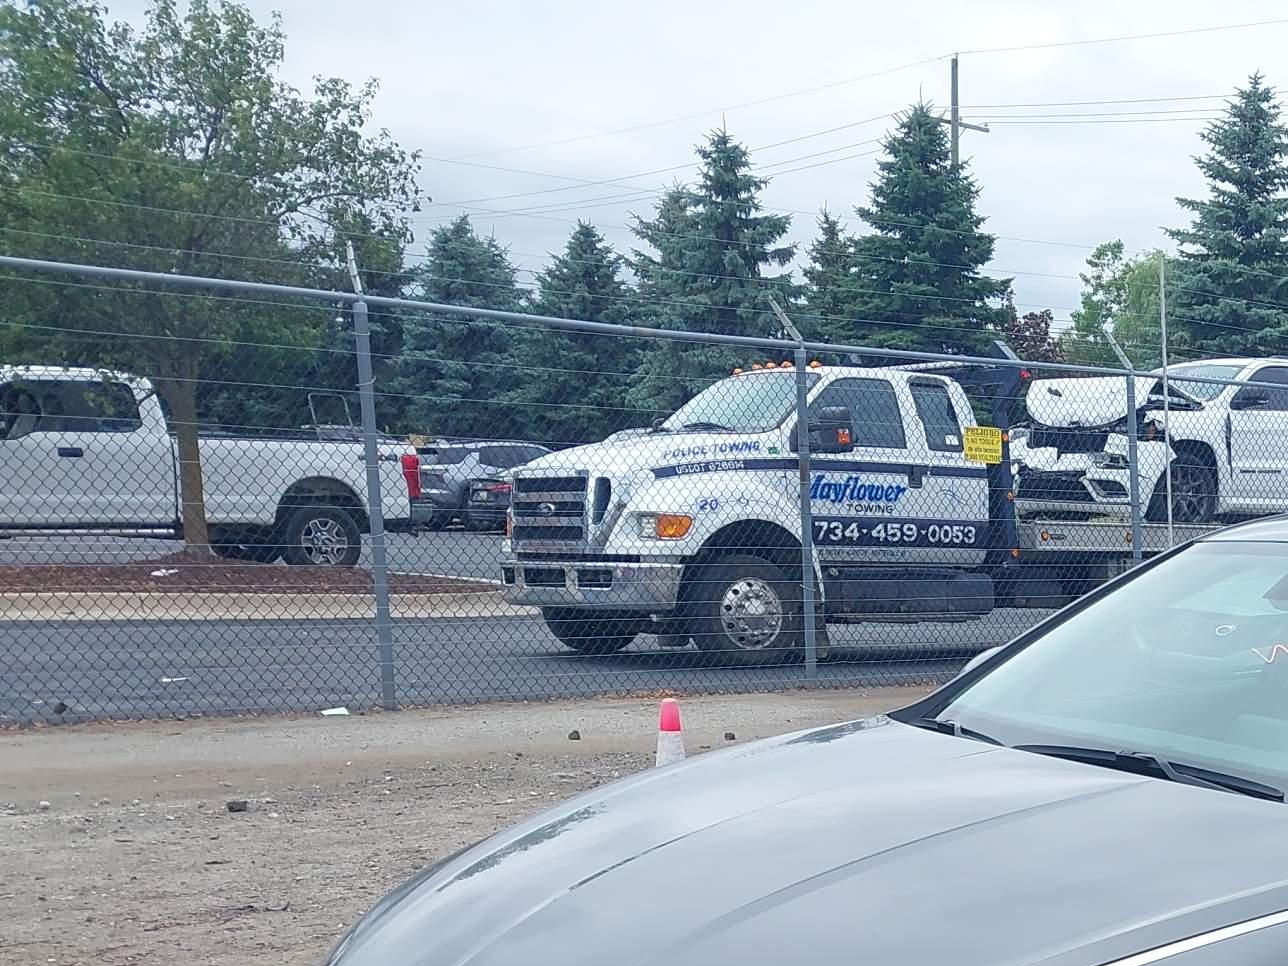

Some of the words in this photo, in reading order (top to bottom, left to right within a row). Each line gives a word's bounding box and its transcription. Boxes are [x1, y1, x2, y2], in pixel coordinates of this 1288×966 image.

[664, 446, 707, 460] POLICE
[713, 440, 760, 454] TOWING
[675, 463, 706, 475] USDOT
[846, 503, 895, 514] TOWING
